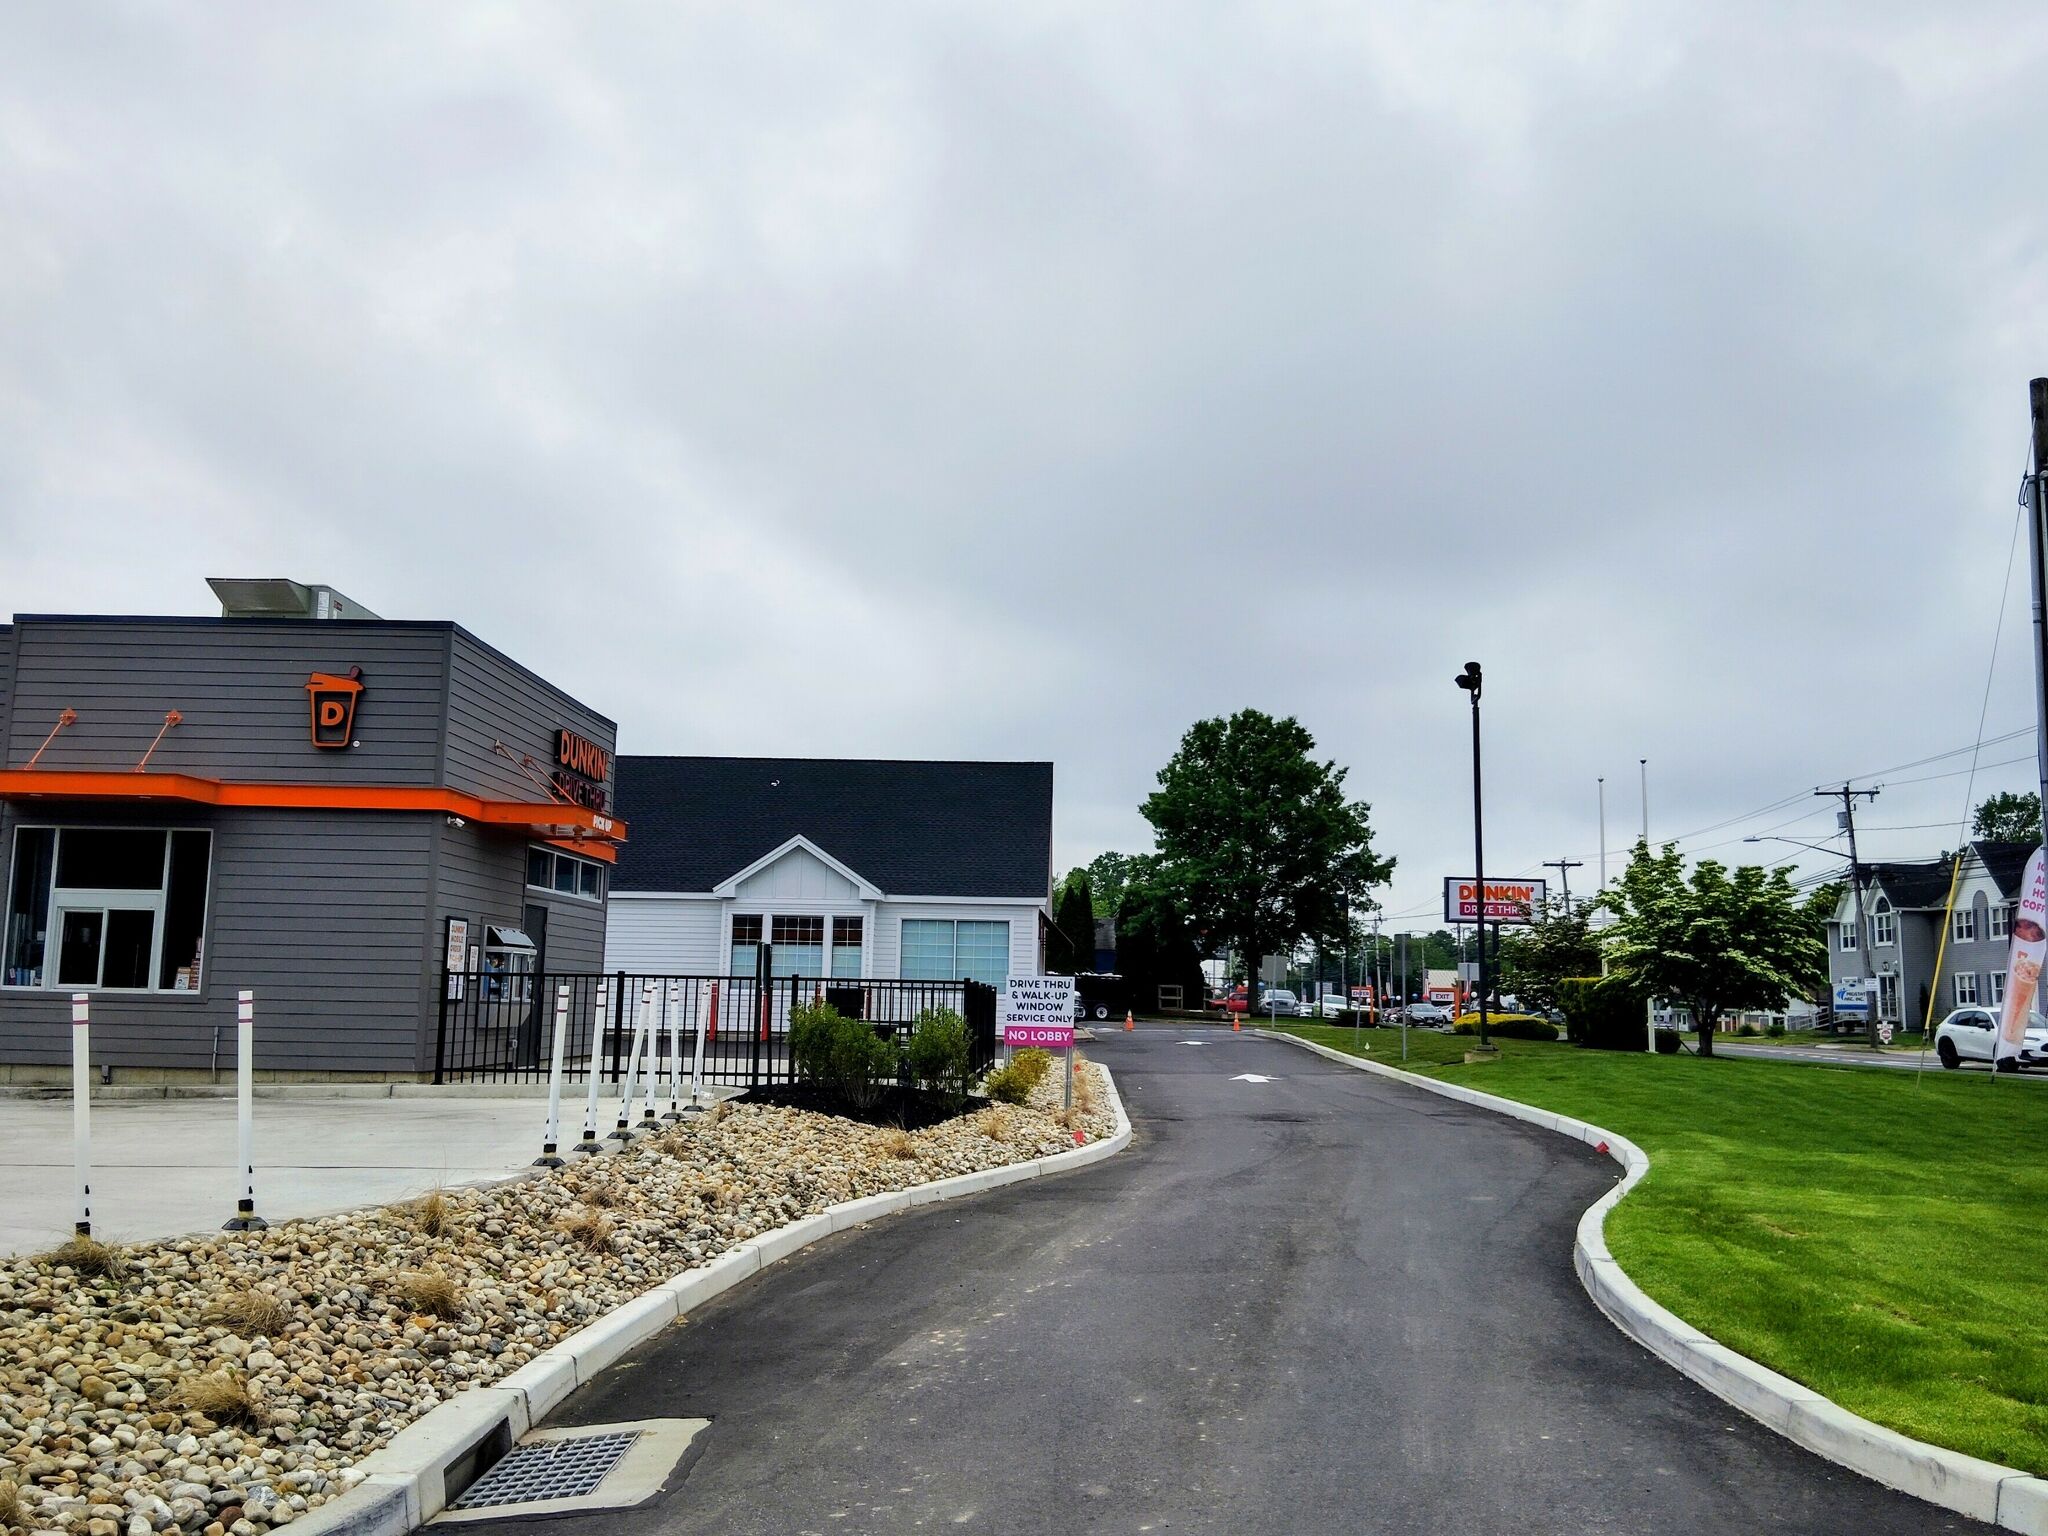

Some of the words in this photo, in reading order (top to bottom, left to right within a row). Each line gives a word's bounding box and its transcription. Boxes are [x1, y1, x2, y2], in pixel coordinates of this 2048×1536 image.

[320, 701, 344, 726] D
[1459, 885, 1535, 901] DNKIN'
[2032, 888, 2046, 899] HO
[1464, 905, 1495, 914] DRVE
[1497, 906, 1525, 915] THR
[2022, 899, 2046, 913] COFF
[1009, 979, 1040, 989] DRIVE
[1043, 980, 1071, 989] THRU
[1011, 991, 1019, 1000] &
[1021, 991, 1068, 1000] WALK-UP
[1016, 1002, 1064, 1011] WINDOW
[1006, 1013, 1045, 1022] SERVICE
[1047, 1014, 1073, 1023] ONLY
[1008, 1030, 1028, 1041] NO
[1030, 1031, 1070, 1042] LOBBY
